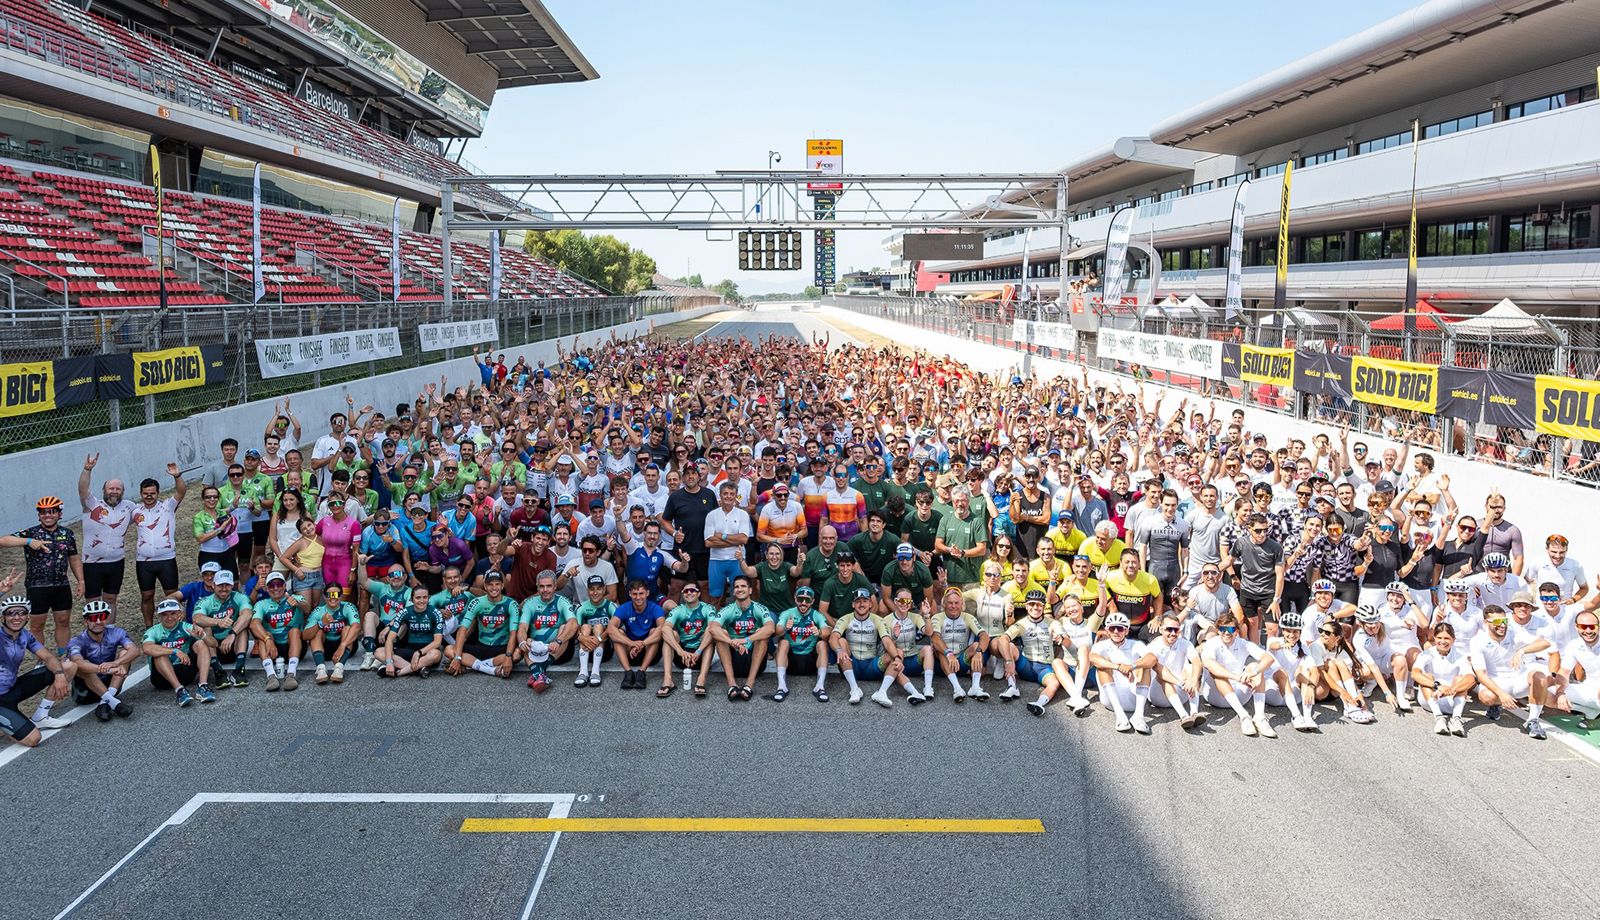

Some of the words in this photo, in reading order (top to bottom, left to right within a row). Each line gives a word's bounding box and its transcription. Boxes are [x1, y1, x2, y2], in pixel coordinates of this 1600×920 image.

[305, 82, 349, 119] Barcelona
[139, 359, 174, 387] SOLO
[174, 352, 200, 382] BICI
[1242, 352, 1270, 376] SOLO
[6, 369, 48, 407] BICI
[1355, 365, 1396, 397] SOLO
[1398, 370, 1433, 403] BICI
[270, 612, 293, 620] KERN
